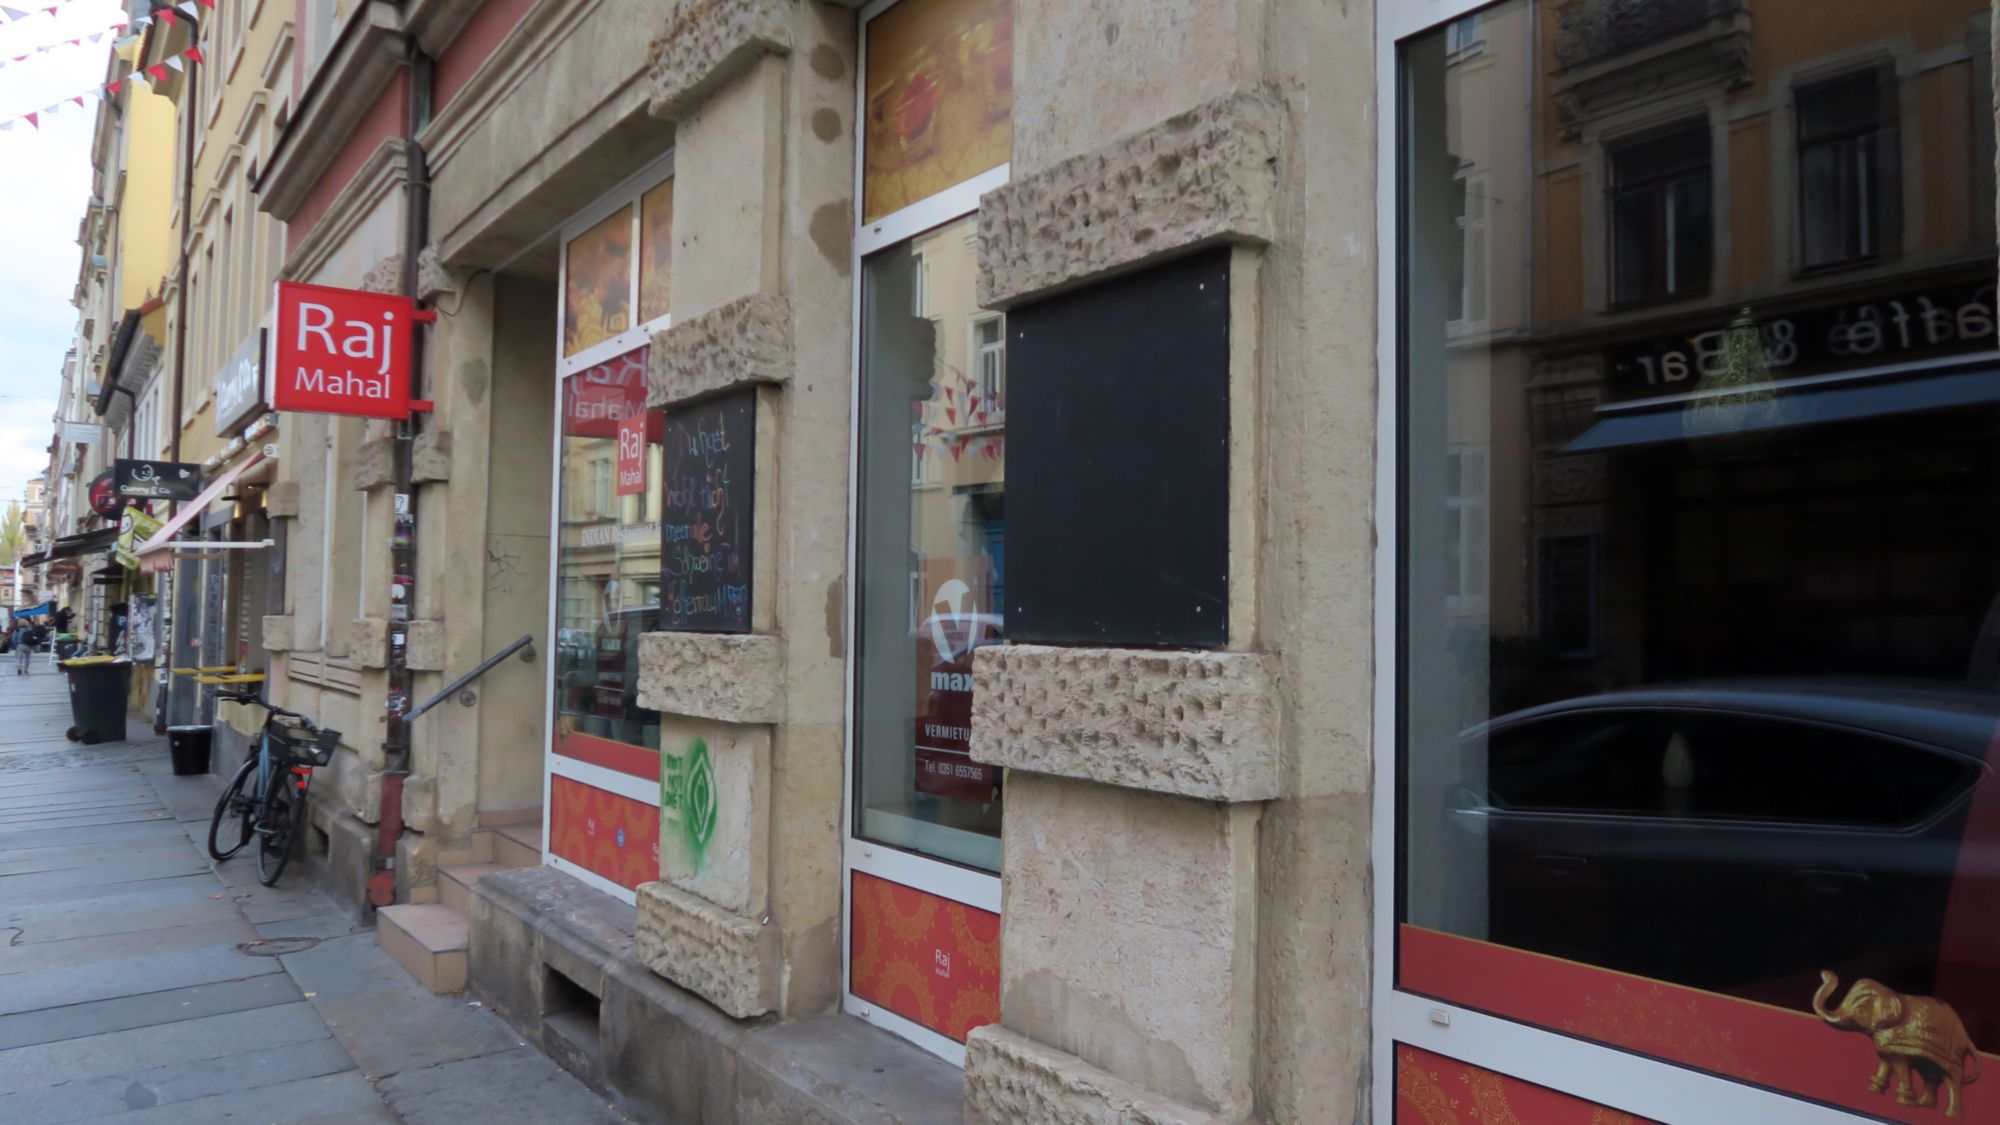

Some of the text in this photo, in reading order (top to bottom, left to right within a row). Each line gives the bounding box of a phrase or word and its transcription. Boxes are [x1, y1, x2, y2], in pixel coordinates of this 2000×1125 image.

[297, 301, 394, 375] Raj
[295, 366, 390, 399] Mahal
[620, 422, 644, 467] Raj
[619, 464, 643, 487] Mahal
[581, 527, 610, 546] INDIAN
[925, 724, 971, 741] VERMIETU
[925, 760, 982, 781] Tel. 0351 6557565
[935, 949, 949, 973] Raj
